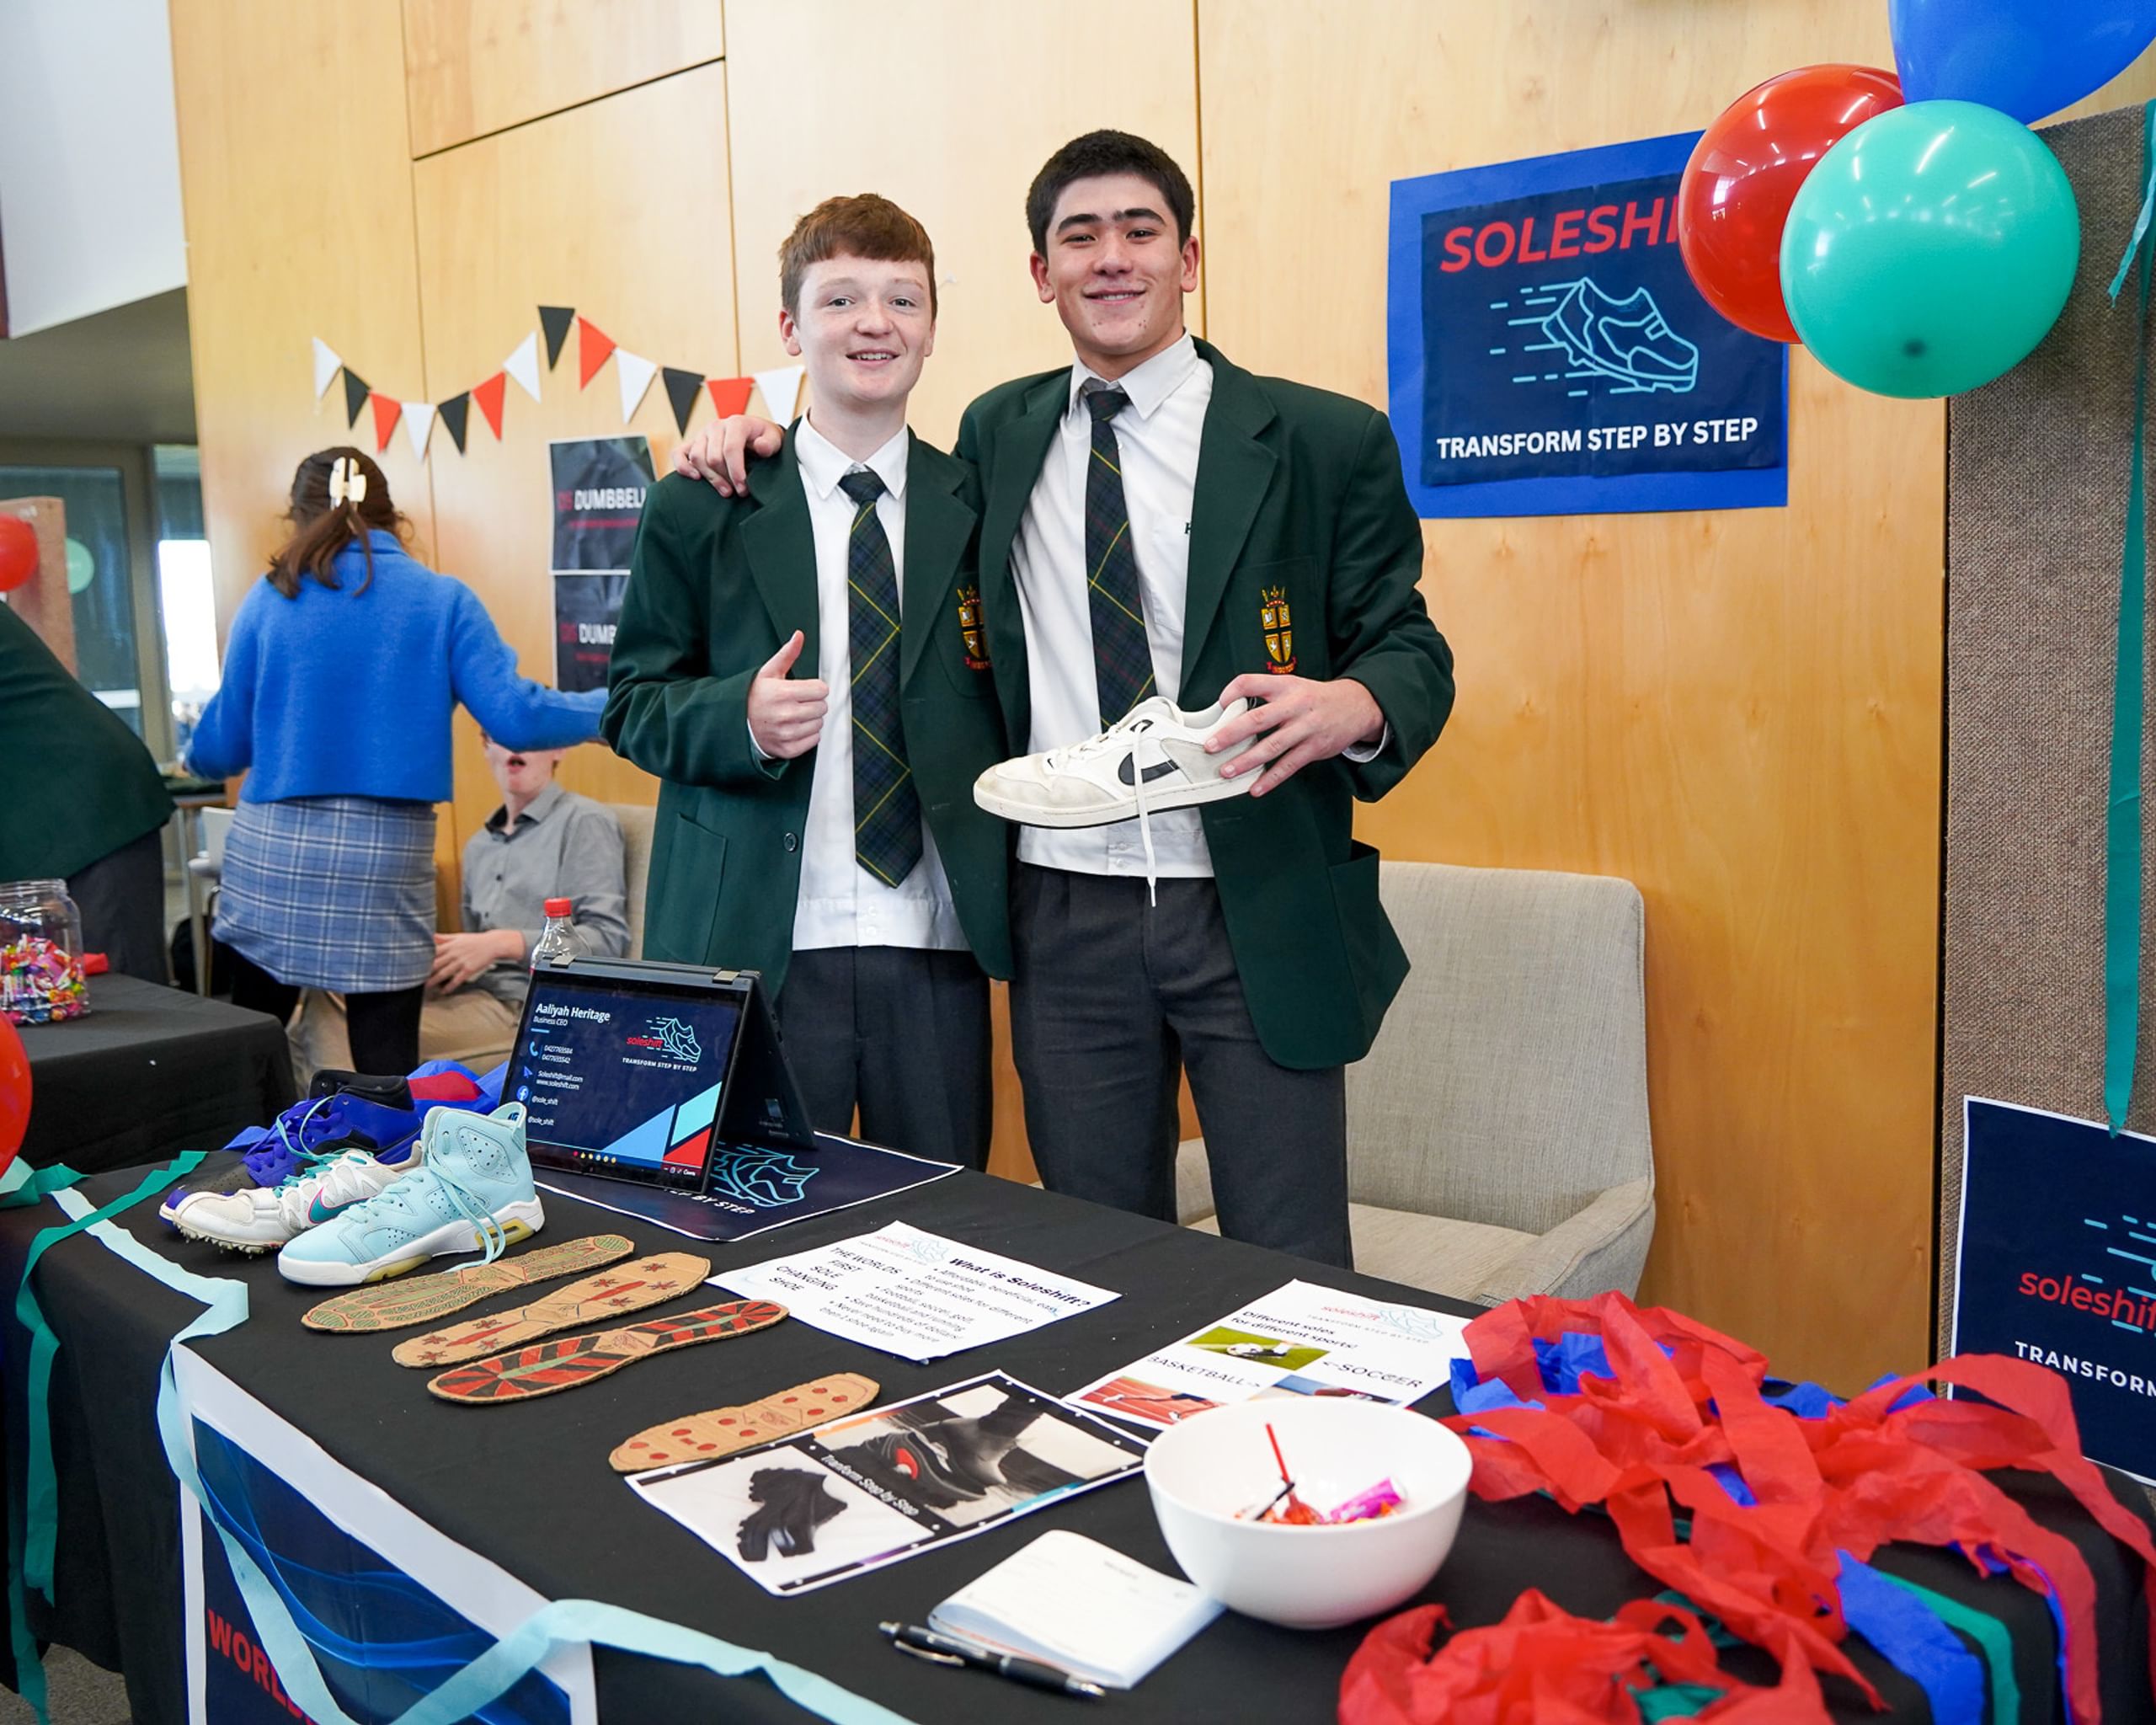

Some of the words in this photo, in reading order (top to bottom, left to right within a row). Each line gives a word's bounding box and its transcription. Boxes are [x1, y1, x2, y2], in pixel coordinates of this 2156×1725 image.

[1437, 430, 1582, 459] TRANSFORM
[1588, 425, 1647, 451] STEP
[1654, 422, 1689, 446] BY
[1693, 418, 1758, 443] STEP
[532, 1016, 556, 1025] Business
[535, 1003, 569, 1017] Aaliyah
[570, 1007, 611, 1023] Heritage
[626, 1037, 664, 1048] soleshift
[622, 1057, 657, 1067] TRANSFORM
[691, 1195, 718, 1204] BY
[713, 1201, 755, 1214] STEP
[828, 1259, 862, 1273] FIRST
[830, 1247, 855, 1260] THE
[856, 1254, 903, 1275] WORLDS
[776, 1266, 839, 1291] CHANGING
[809, 1265, 844, 1279] SOLE
[949, 1258, 990, 1274] What
[989, 1270, 1006, 1279] is
[1006, 1276, 1091, 1306] Soleshift?
[769, 1277, 805, 1292] SHOE
[1243, 1311, 1301, 1328] Different
[1302, 1323, 1336, 1336] soles
[1321, 1306, 1381, 1322] soleshift
[1230, 1316, 1251, 1326] for
[1251, 1322, 1309, 1339] different
[1311, 1334, 1358, 1349] sports!
[859, 1478, 885, 1495] Step
[879, 1491, 899, 1503] by
[893, 1498, 920, 1517] Step
[208, 1608, 318, 1725] WORL
